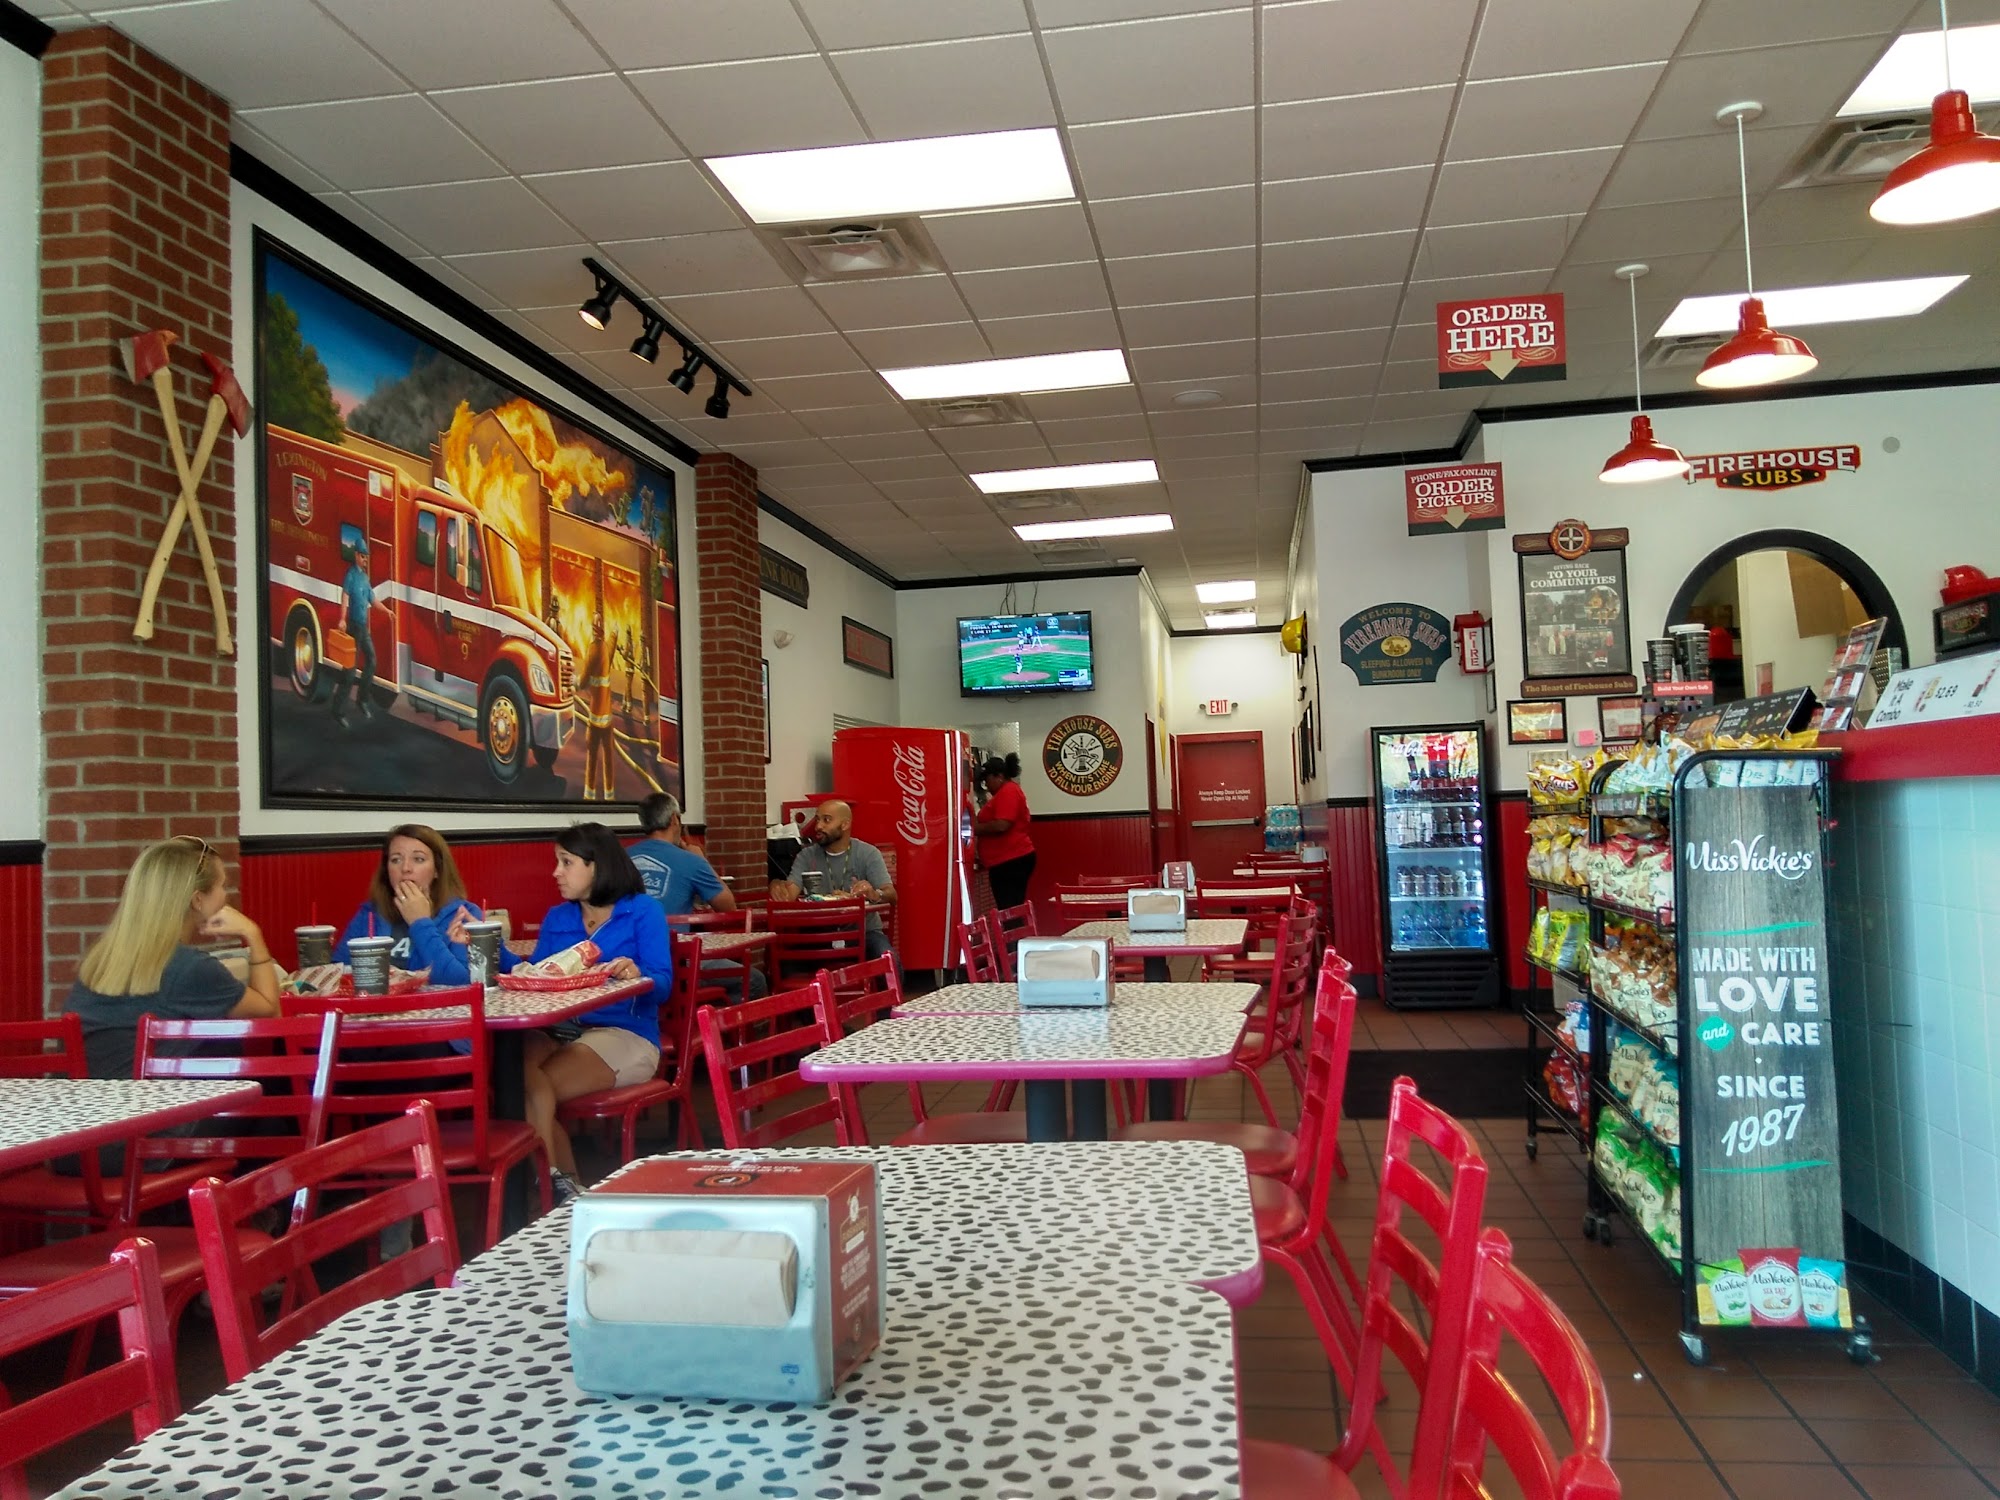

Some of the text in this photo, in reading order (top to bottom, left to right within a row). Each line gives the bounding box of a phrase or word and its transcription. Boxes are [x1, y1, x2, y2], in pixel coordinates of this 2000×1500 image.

[1452, 303, 1547, 327] ORDER
[1447, 321, 1555, 353] HERE
[1410, 468, 1497, 484] PHONE/FAX/ONLINE
[1688, 447, 1857, 485] FIREHOUSE
[1742, 469, 1803, 486] SUBS
[1415, 477, 1495, 497] ORDER
[1416, 492, 1495, 509] PICK-UPS
[1530, 575, 1617, 589] COMMUNITIES
[1547, 568, 1599, 579] TO YOUR
[1358, 607, 1432, 623] WELCOME TO
[1344, 616, 1413, 655] FIREHOUSE
[461, 642, 468, 660] 9
[1469, 631, 1480, 667] FIRE
[1541, 684, 1563, 692] Heart
[1573, 682, 1613, 691] Firehouse
[1210, 699, 1228, 714] EXIT
[1875, 709, 1902, 722] Combo
[1047, 717, 1118, 752] FIREHOUSE SUBS
[1049, 764, 1118, 793] TO FILL YOUR ENGINE
[1056, 760, 1110, 783] WHEN IT'S TIME
[893, 740, 928, 845] Coca-Cola
[1686, 834, 1814, 880] Miss Vickie's
[1692, 946, 1816, 972] MADE WITH
[1694, 976, 1818, 1012] LOVE
[1702, 1022, 1820, 1046] and CARE
[1717, 1075, 1806, 1099] SINCE
[1721, 1103, 1805, 1157] 1987
[1753, 1271, 1796, 1285] Miss Vickie's
